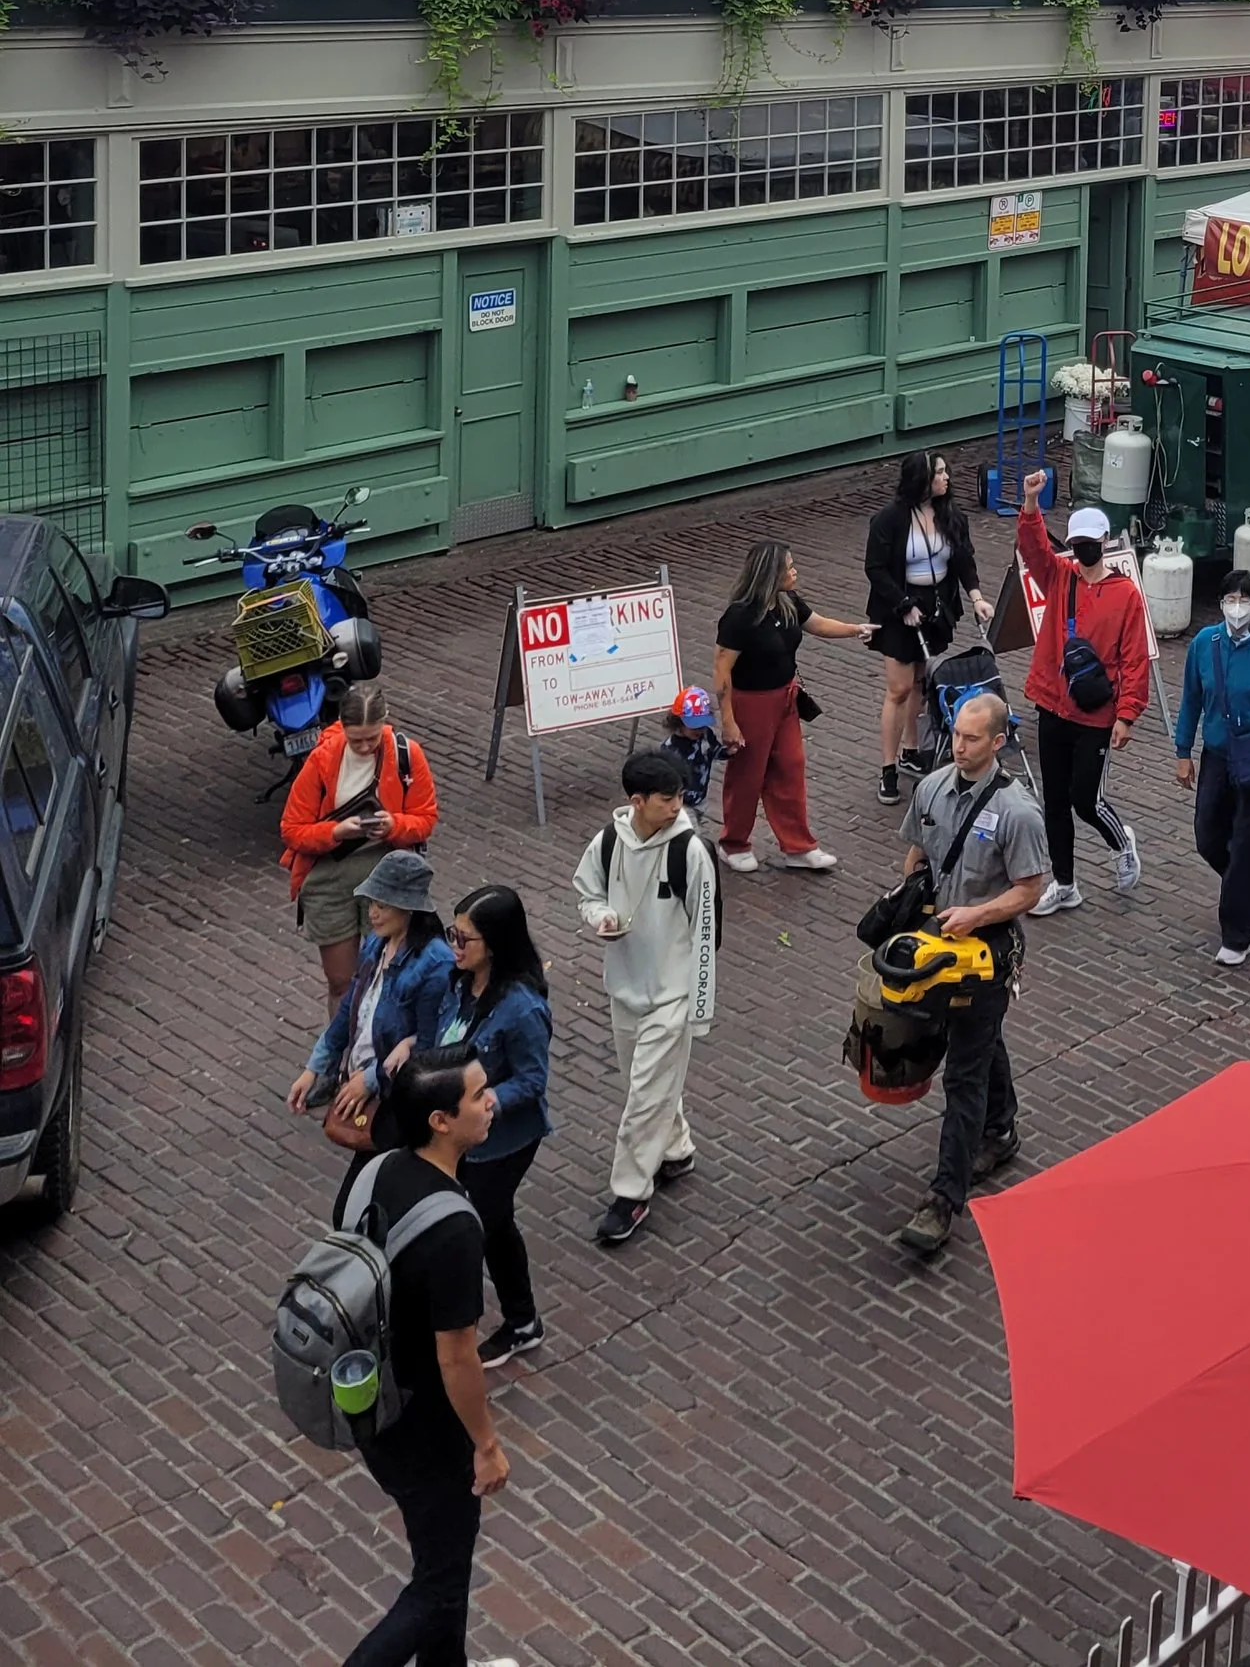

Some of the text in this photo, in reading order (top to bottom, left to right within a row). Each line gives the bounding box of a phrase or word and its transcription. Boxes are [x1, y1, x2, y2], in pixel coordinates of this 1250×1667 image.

[473, 292, 512, 309] NOTICE
[471, 313, 514, 327] BLOCK DOOR
[480, 309, 505, 319] DO NOT
[527, 612, 563, 646] NO
[609, 597, 664, 627] KING
[531, 653, 565, 669] FROM
[542, 678, 558, 691] TO
[555, 680, 655, 707] TOW-AWAY AREA
[573, 702, 598, 712] PHONE
[696, 881, 712, 1019] BOULDER COLORADO
